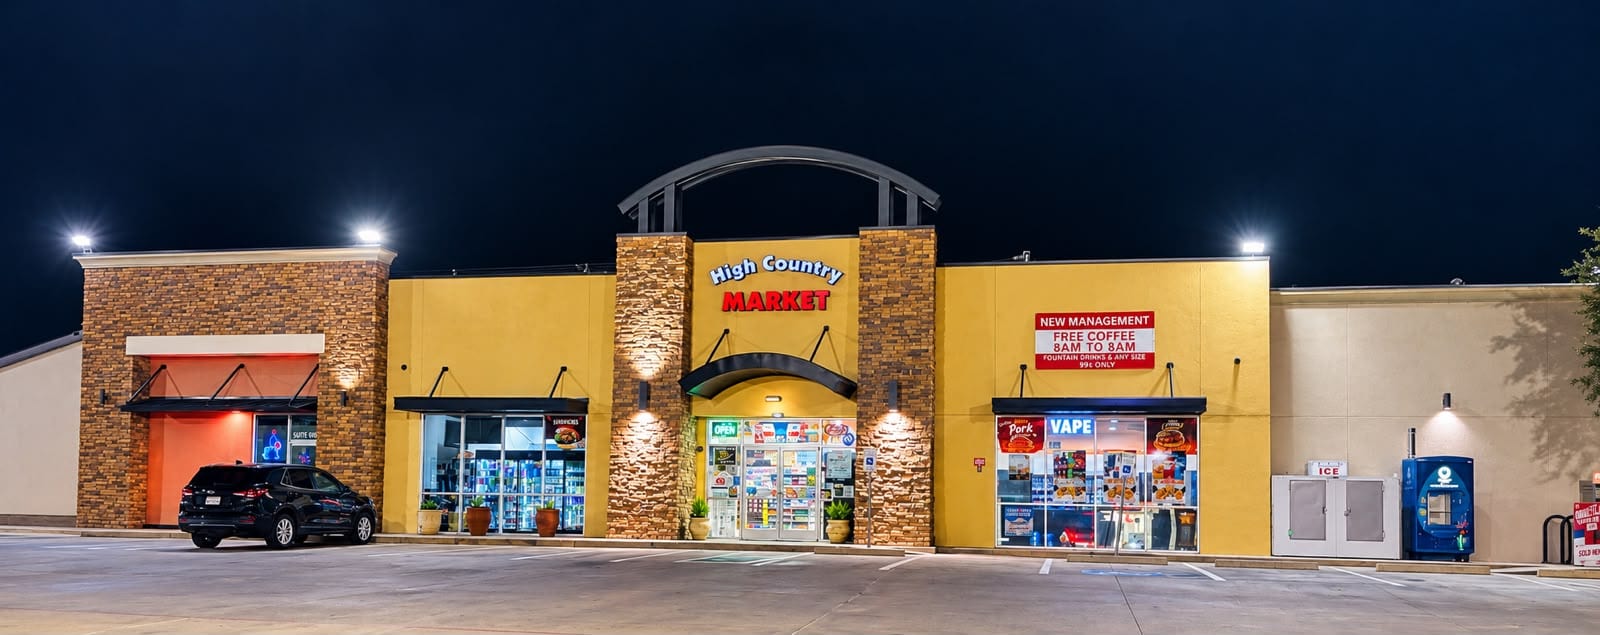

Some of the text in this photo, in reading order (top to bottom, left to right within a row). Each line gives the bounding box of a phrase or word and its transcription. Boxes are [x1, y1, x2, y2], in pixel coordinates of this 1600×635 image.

[709, 255, 844, 285] High Country
[722, 290, 830, 312] MARKET
[1040, 315, 1149, 327] NEW MANAGEMENT
[1053, 330, 1135, 342] FREE COFFEE
[1053, 341, 1136, 353] 8AM TO 8AM
[1094, 361, 1116, 369] ONLY
[714, 423, 736, 435] OPEN
[1009, 422, 1033, 436] Pork
[1050, 418, 1092, 434] VAPE
[292, 431, 308, 439] SUITE
[1319, 467, 1339, 475] ICE
[1578, 549, 1592, 557] SOLD
